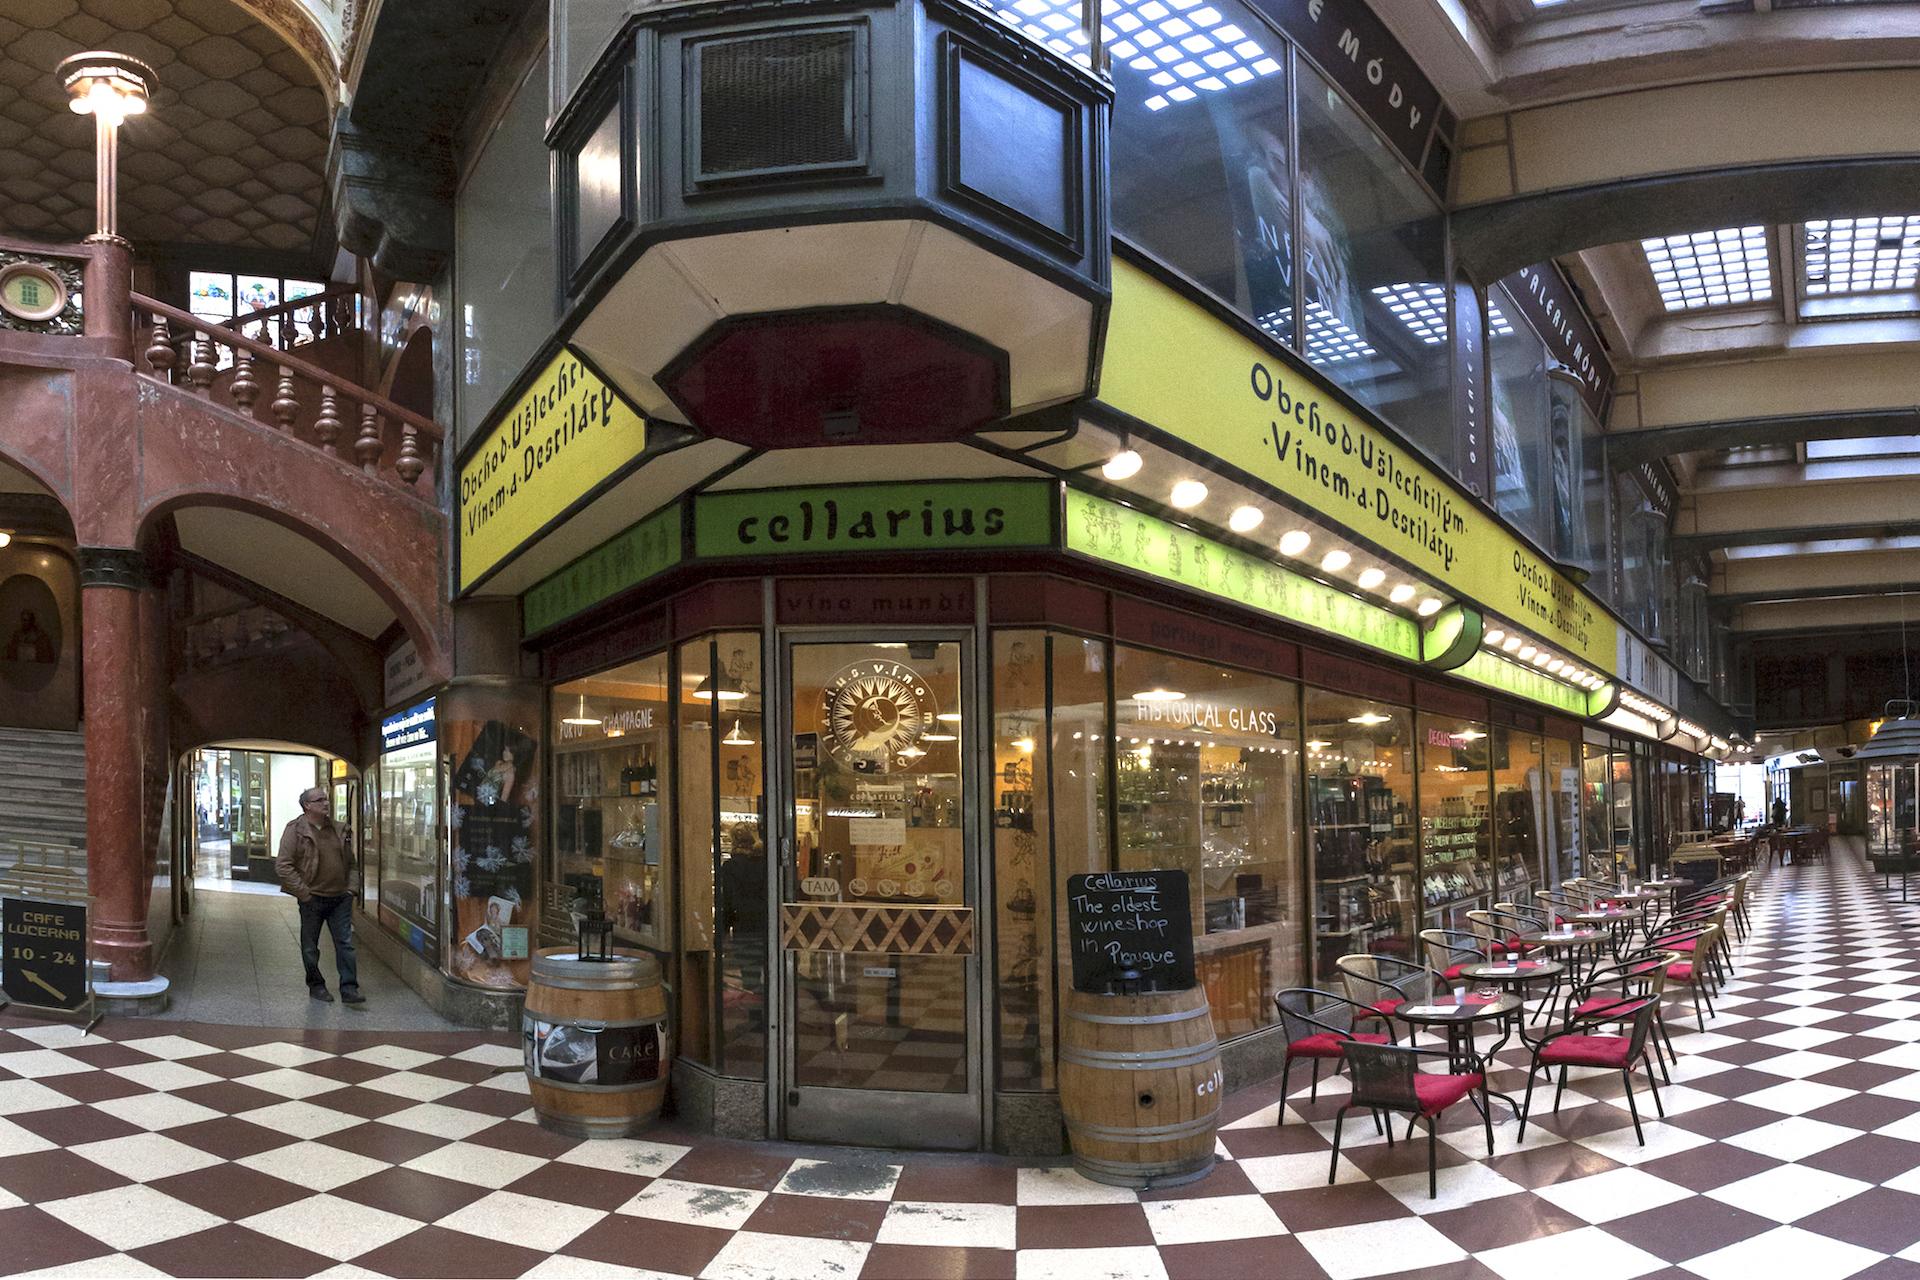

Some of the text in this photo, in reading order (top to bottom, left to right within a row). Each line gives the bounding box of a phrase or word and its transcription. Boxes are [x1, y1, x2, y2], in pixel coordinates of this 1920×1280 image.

[1338, 28, 1421, 130] MÓDY
[1574, 343, 1600, 391] MÓDY
[737, 499, 1005, 545] cellarius
[602, 708, 653, 734] CHAMPAGNE
[1137, 699, 1276, 735] HISTORICAL GLASS
[806, 880, 836, 892] TAM
[1084, 873, 1157, 891] Cellarius
[1072, 894, 1161, 913] The oldest
[22, 911, 64, 926] CAFE
[1081, 913, 1168, 937] wineshop
[8, 923, 80, 940] LUCERNA
[12, 947, 34, 960] 10
[52, 951, 77, 965] 24
[1104, 941, 1176, 970] Prague
[1197, 1069, 1223, 1096] cell
